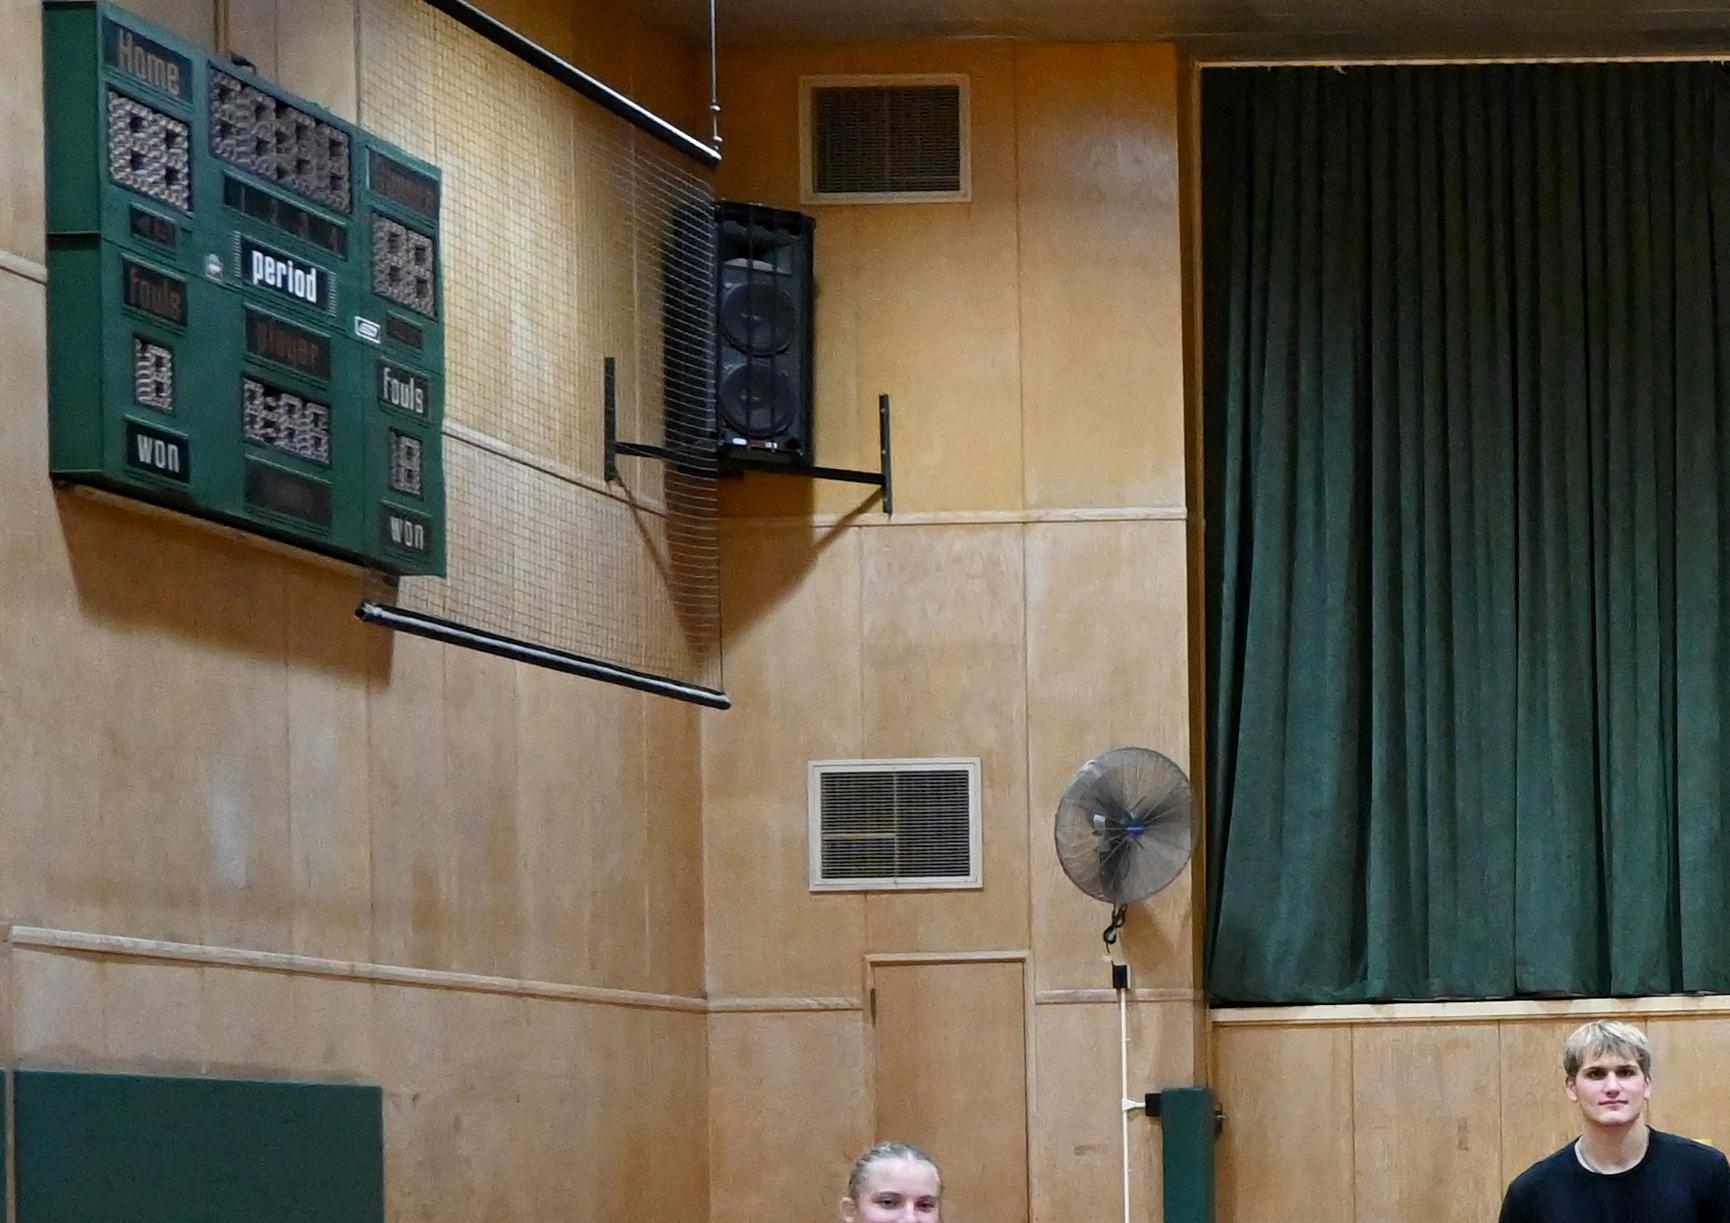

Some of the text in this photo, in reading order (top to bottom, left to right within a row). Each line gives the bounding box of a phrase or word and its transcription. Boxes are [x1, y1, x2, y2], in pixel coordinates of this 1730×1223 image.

[118, 29, 180, 96] Home
[252, 249, 317, 303] period
[136, 433, 180, 473] won
[390, 516, 424, 550] won
